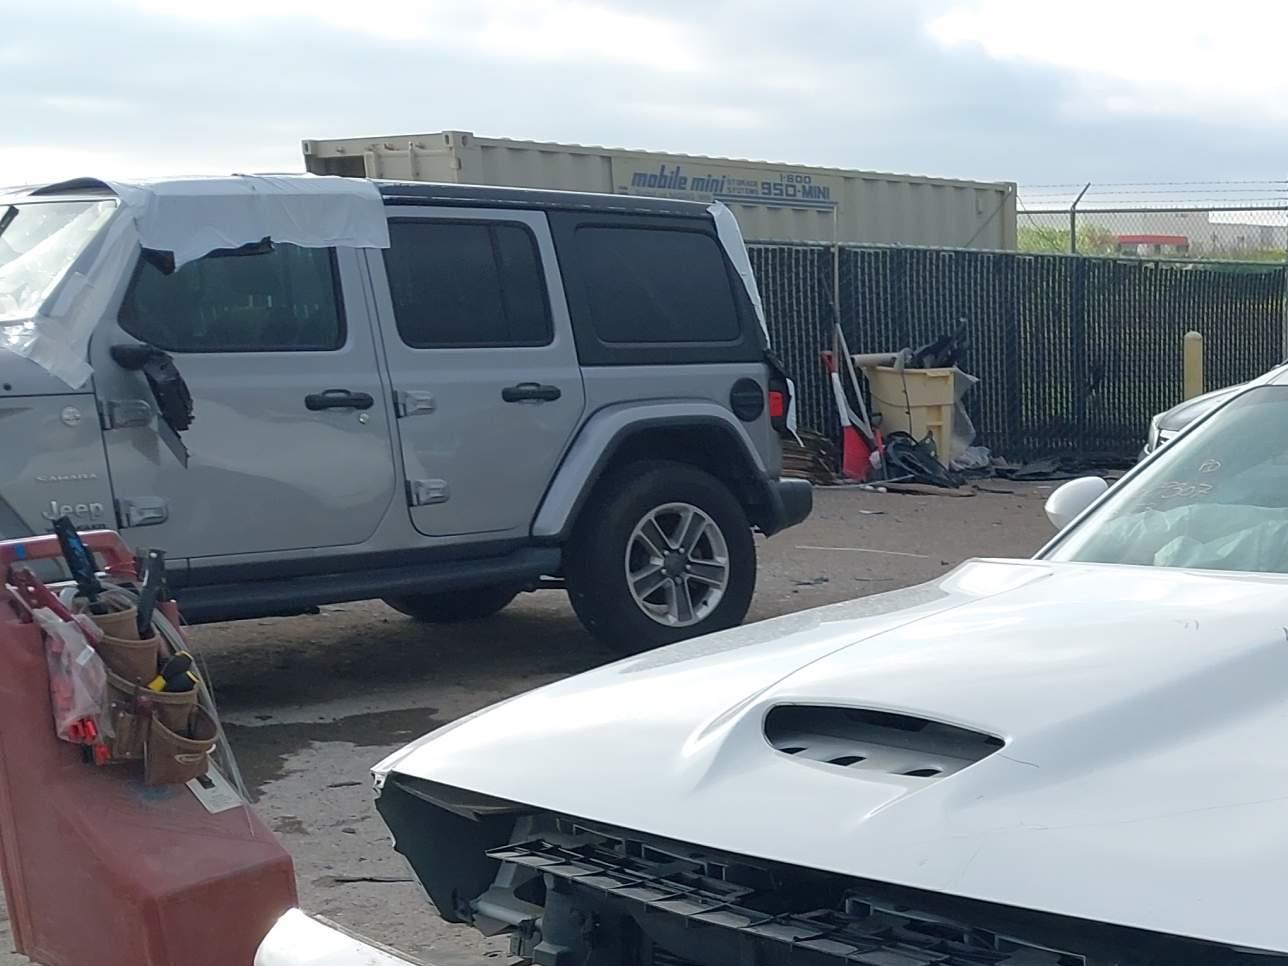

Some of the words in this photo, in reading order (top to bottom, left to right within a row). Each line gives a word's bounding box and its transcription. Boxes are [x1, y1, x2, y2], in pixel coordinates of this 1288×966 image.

[631, 164, 688, 191] mobile
[690, 173, 726, 193] mini
[761, 181, 830, 200] 950-MINI
[42, 500, 105, 521] Jeep
